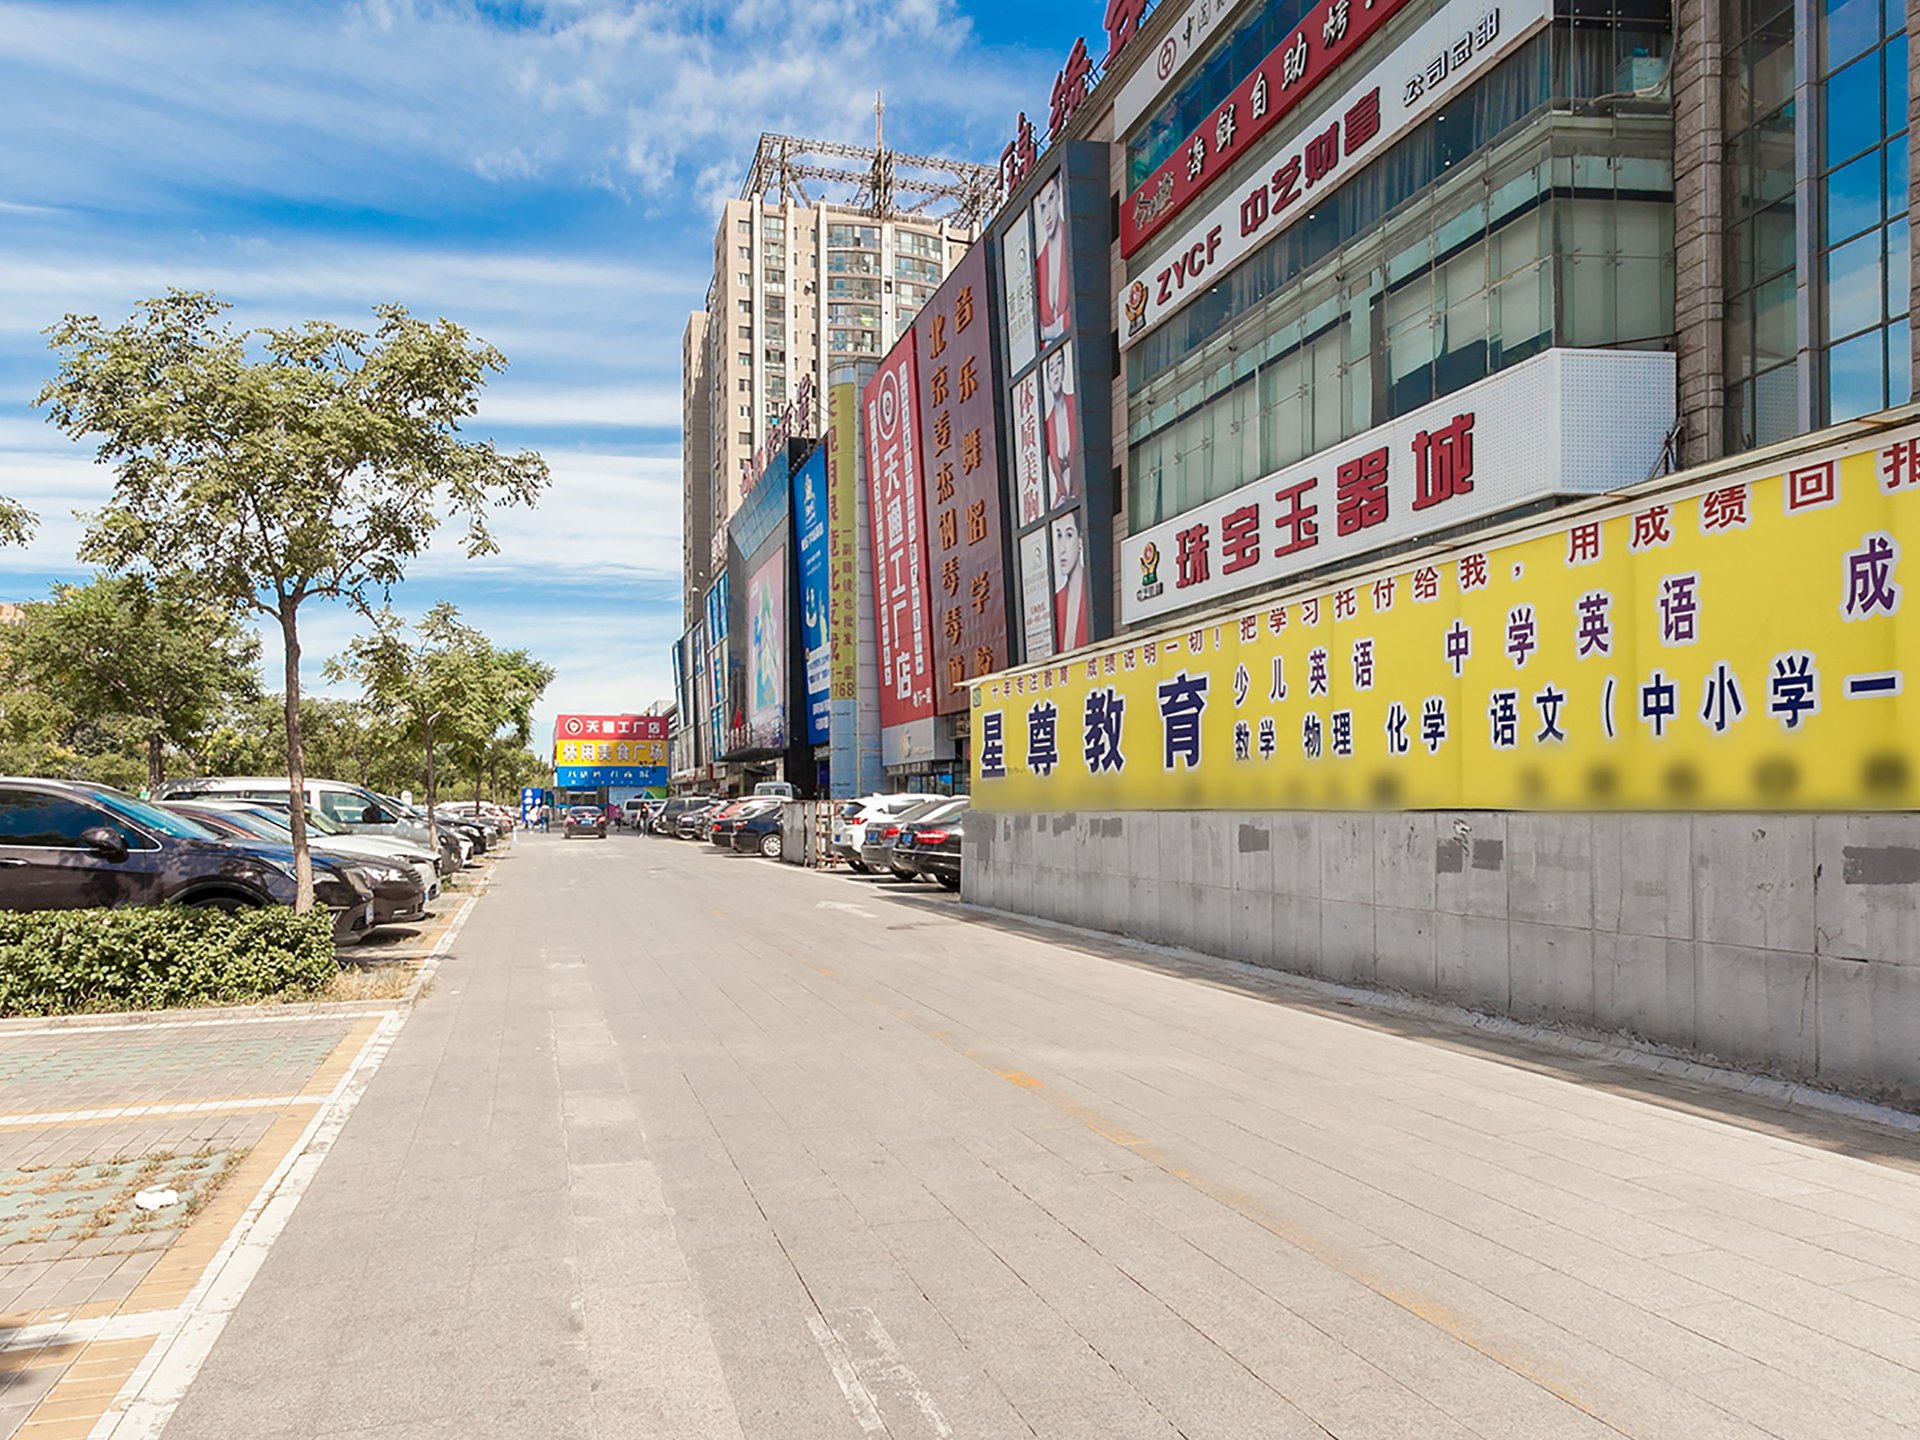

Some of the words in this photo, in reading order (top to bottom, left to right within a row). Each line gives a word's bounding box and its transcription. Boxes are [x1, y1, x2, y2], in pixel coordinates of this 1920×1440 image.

[1156, 224, 1222, 306] ZYCF
[1239, 86, 1381, 238] 中艺财富
[1403, 7, 1500, 107] 公司总部
[1186, 0, 1374, 182] 海鲜自助烤
[1018, 378, 1041, 527] 体质美胸
[1175, 412, 1475, 590] 珠宝玉器城
[980, 673, 1208, 778] 星尊教育
[991, 665, 1070, 701] 十年专注教育
[1234, 640, 1374, 706] 少儿英语
